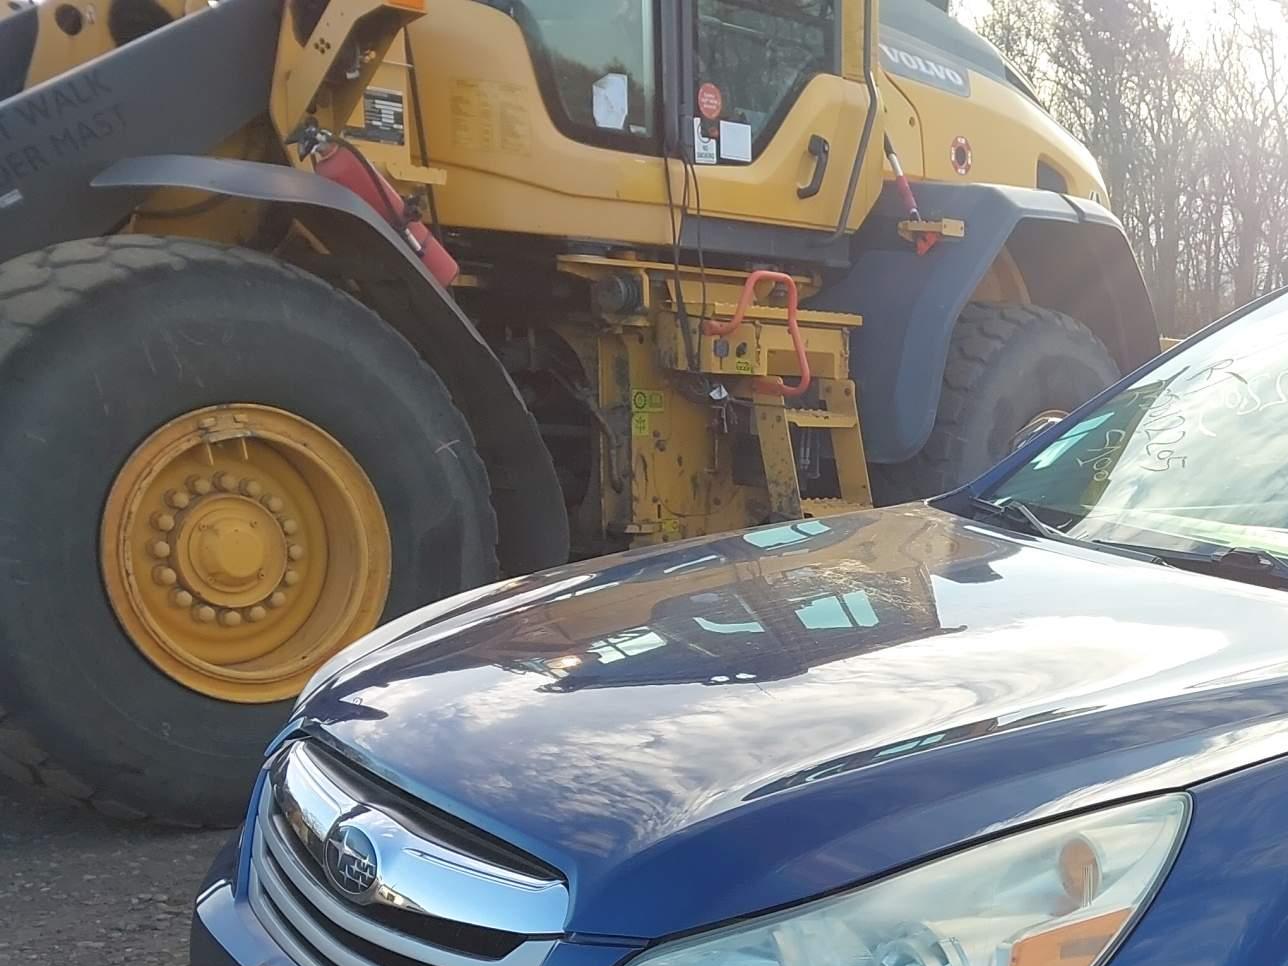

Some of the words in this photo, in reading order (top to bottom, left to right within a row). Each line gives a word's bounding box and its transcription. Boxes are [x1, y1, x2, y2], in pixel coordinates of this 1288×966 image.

[879, 43, 963, 85] VOLVO
[14, 69, 112, 126] WALK
[49, 102, 127, 157] MAST
